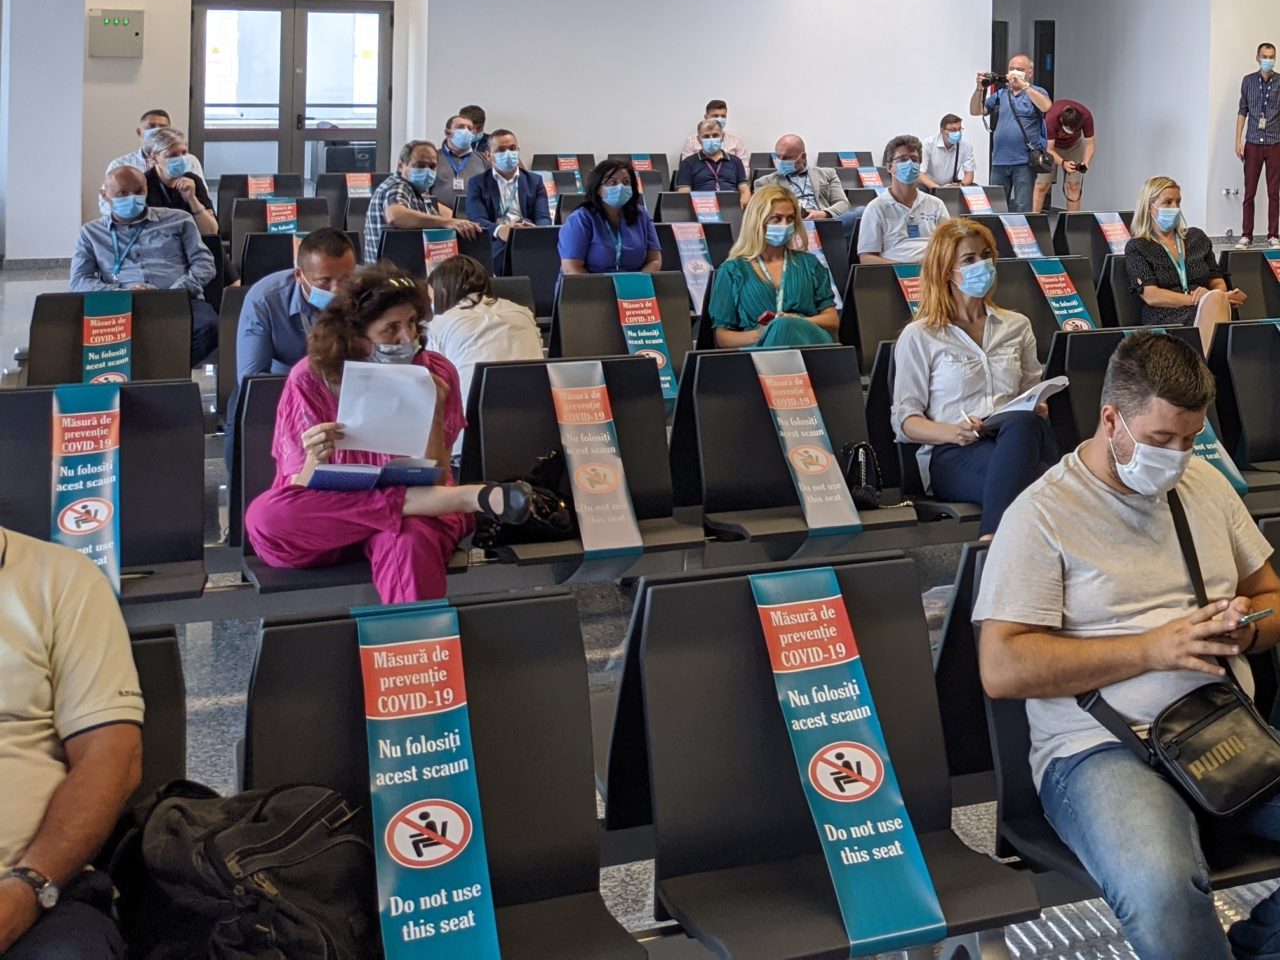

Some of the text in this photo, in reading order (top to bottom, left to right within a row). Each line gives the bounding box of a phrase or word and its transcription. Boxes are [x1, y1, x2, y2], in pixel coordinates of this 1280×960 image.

[100, 414, 112, 426] de
[61, 438, 113, 453] COVID-19
[56, 474, 116, 492] acest scaun
[59, 465, 75, 477] Nu
[95, 541, 114, 552] use
[769, 604, 837, 629] Măsură de
[779, 624, 839, 648] prevenție
[373, 647, 450, 670] Măsură de
[780, 642, 848, 668] COVID-19
[379, 668, 448, 693] prevenție
[377, 687, 455, 714] COVID-19
[787, 679, 862, 709] Nu folosiți
[790, 704, 873, 732] acest scaun
[378, 729, 462, 759] Nu folosiți
[1187, 735, 1247, 781] PUMA
[375, 756, 470, 787] acest scaun
[823, 815, 904, 843] Do not use
[840, 840, 904, 867] this seat
[388, 882, 483, 918] Do not use
[401, 910, 477, 942] this seat
